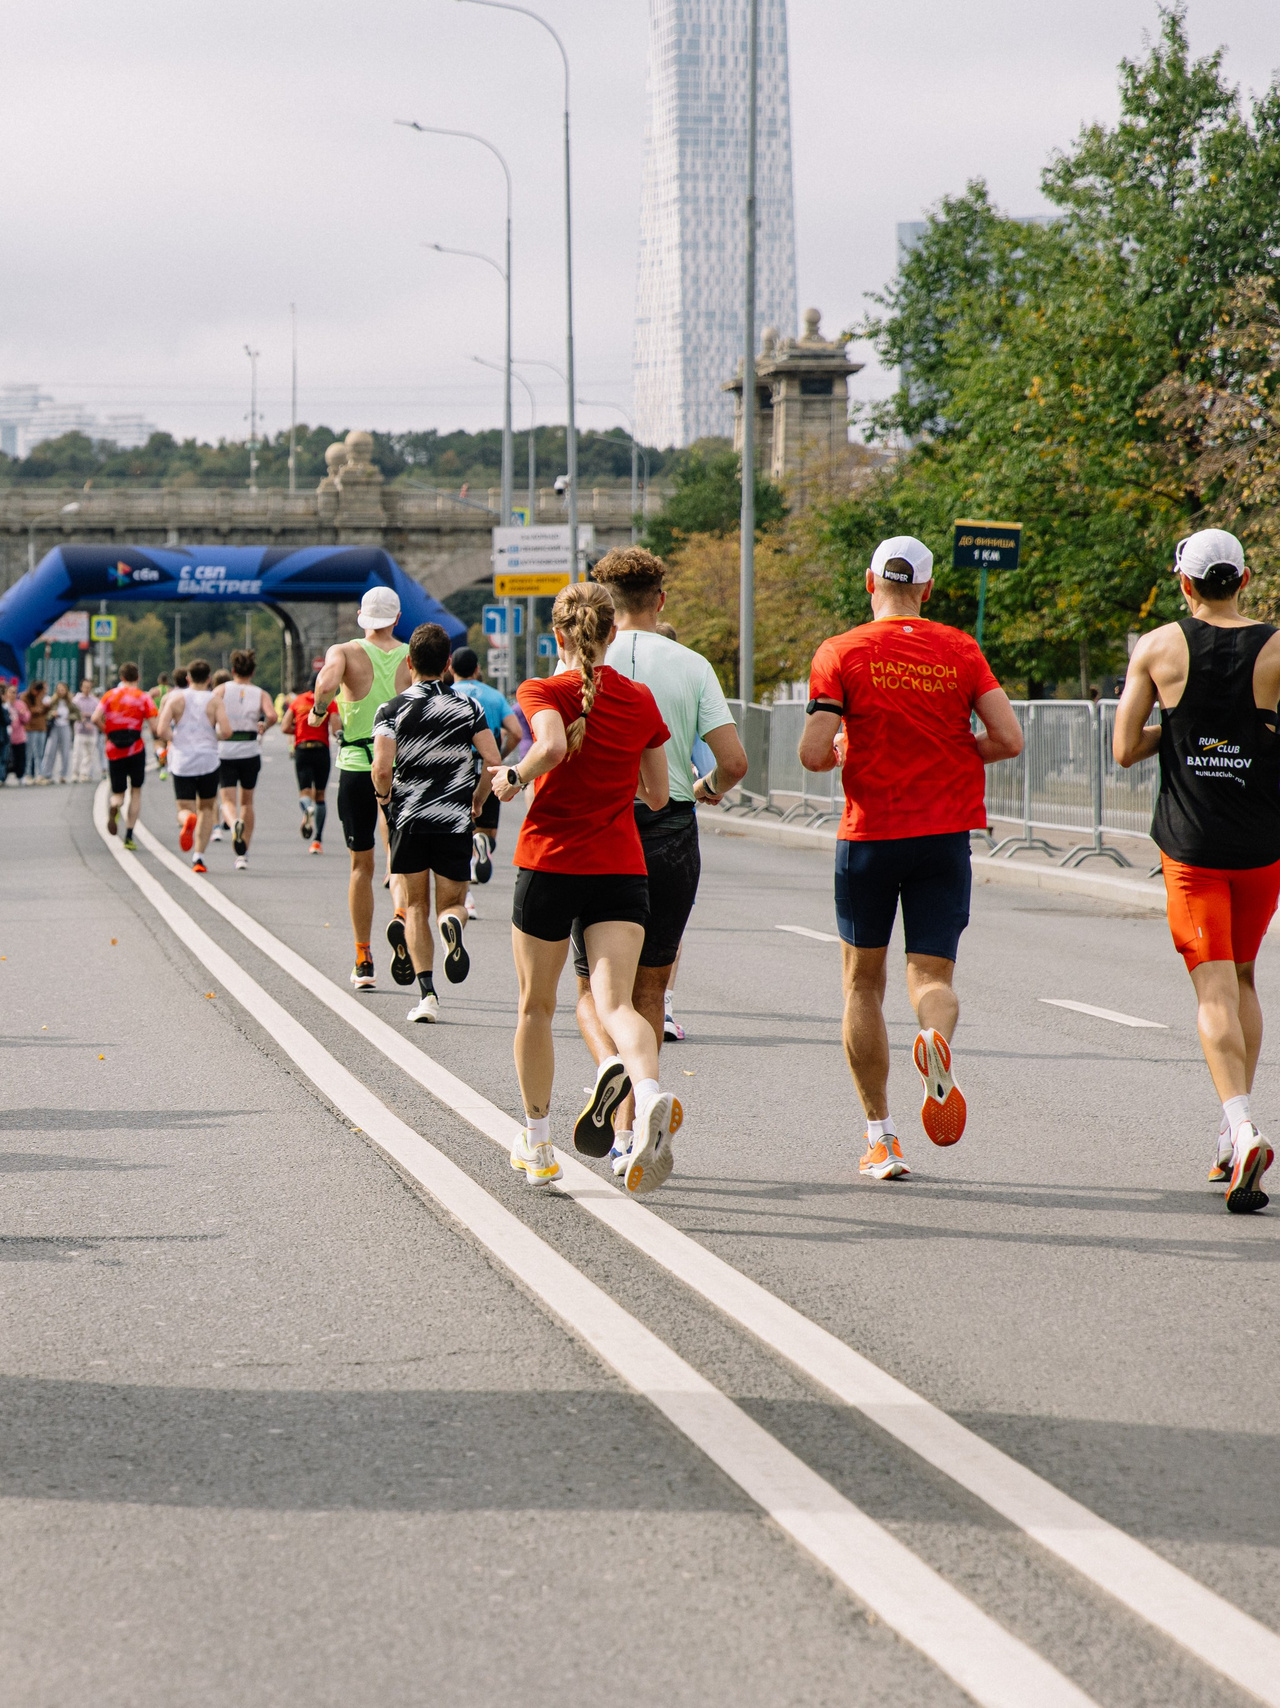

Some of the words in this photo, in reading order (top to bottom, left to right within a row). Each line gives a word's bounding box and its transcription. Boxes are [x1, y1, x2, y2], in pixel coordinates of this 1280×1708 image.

[958, 535, 974, 547] ДО
[974, 536, 1016, 549] ФИНИША
[973, 549, 980, 560] 1
[177, 579, 263, 595] БЫСТРЕЕ
[870, 662, 958, 679] МАРАФОН
[872, 675, 945, 693] МОСКВА
[1198, 737, 1219, 746] RUN
[1217, 744, 1240, 754] CLUB
[1186, 756, 1252, 769] BAYMINOV
